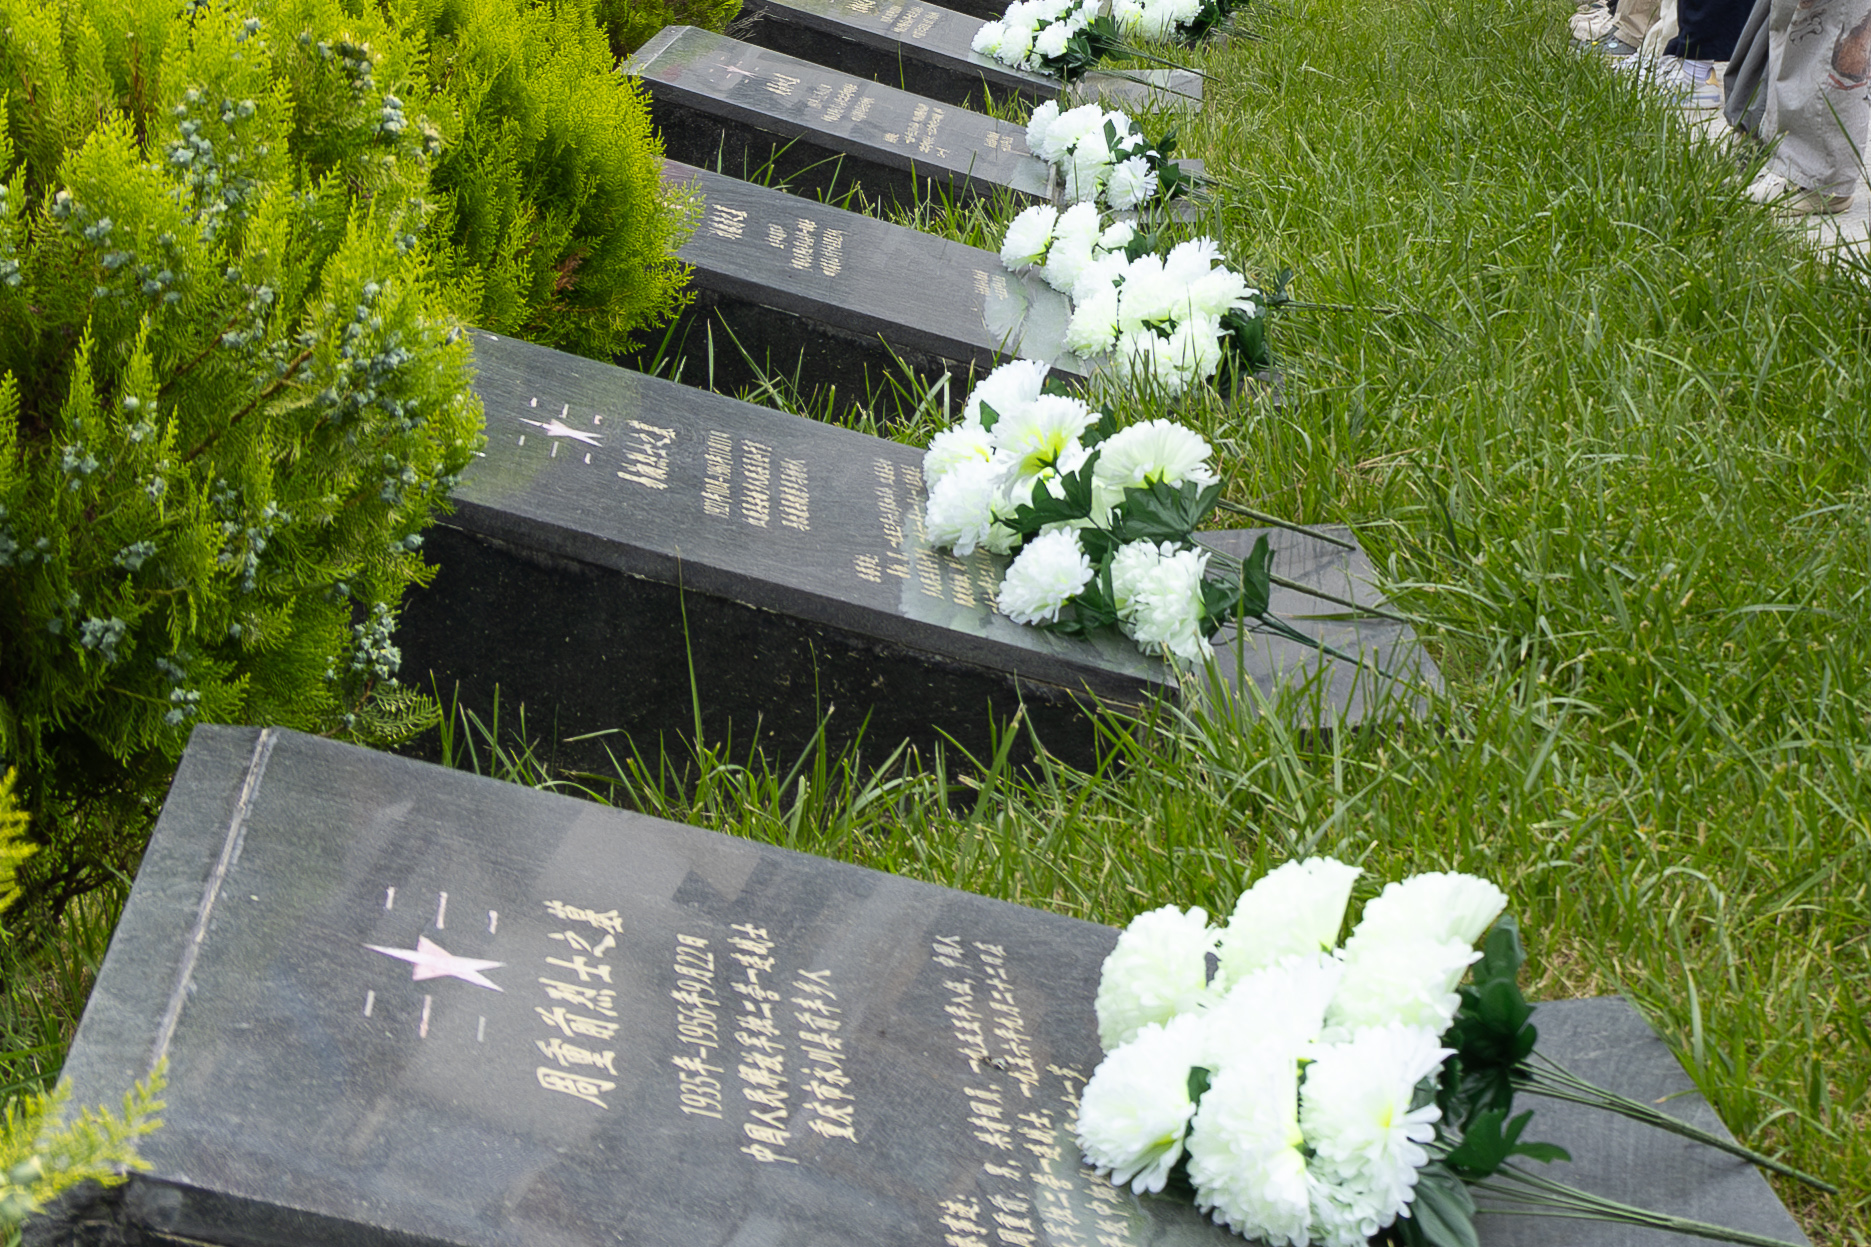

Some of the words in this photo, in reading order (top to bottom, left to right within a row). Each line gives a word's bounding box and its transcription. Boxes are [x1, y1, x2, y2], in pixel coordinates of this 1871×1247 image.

[535, 899, 625, 1110] 周重前烈士之墓
